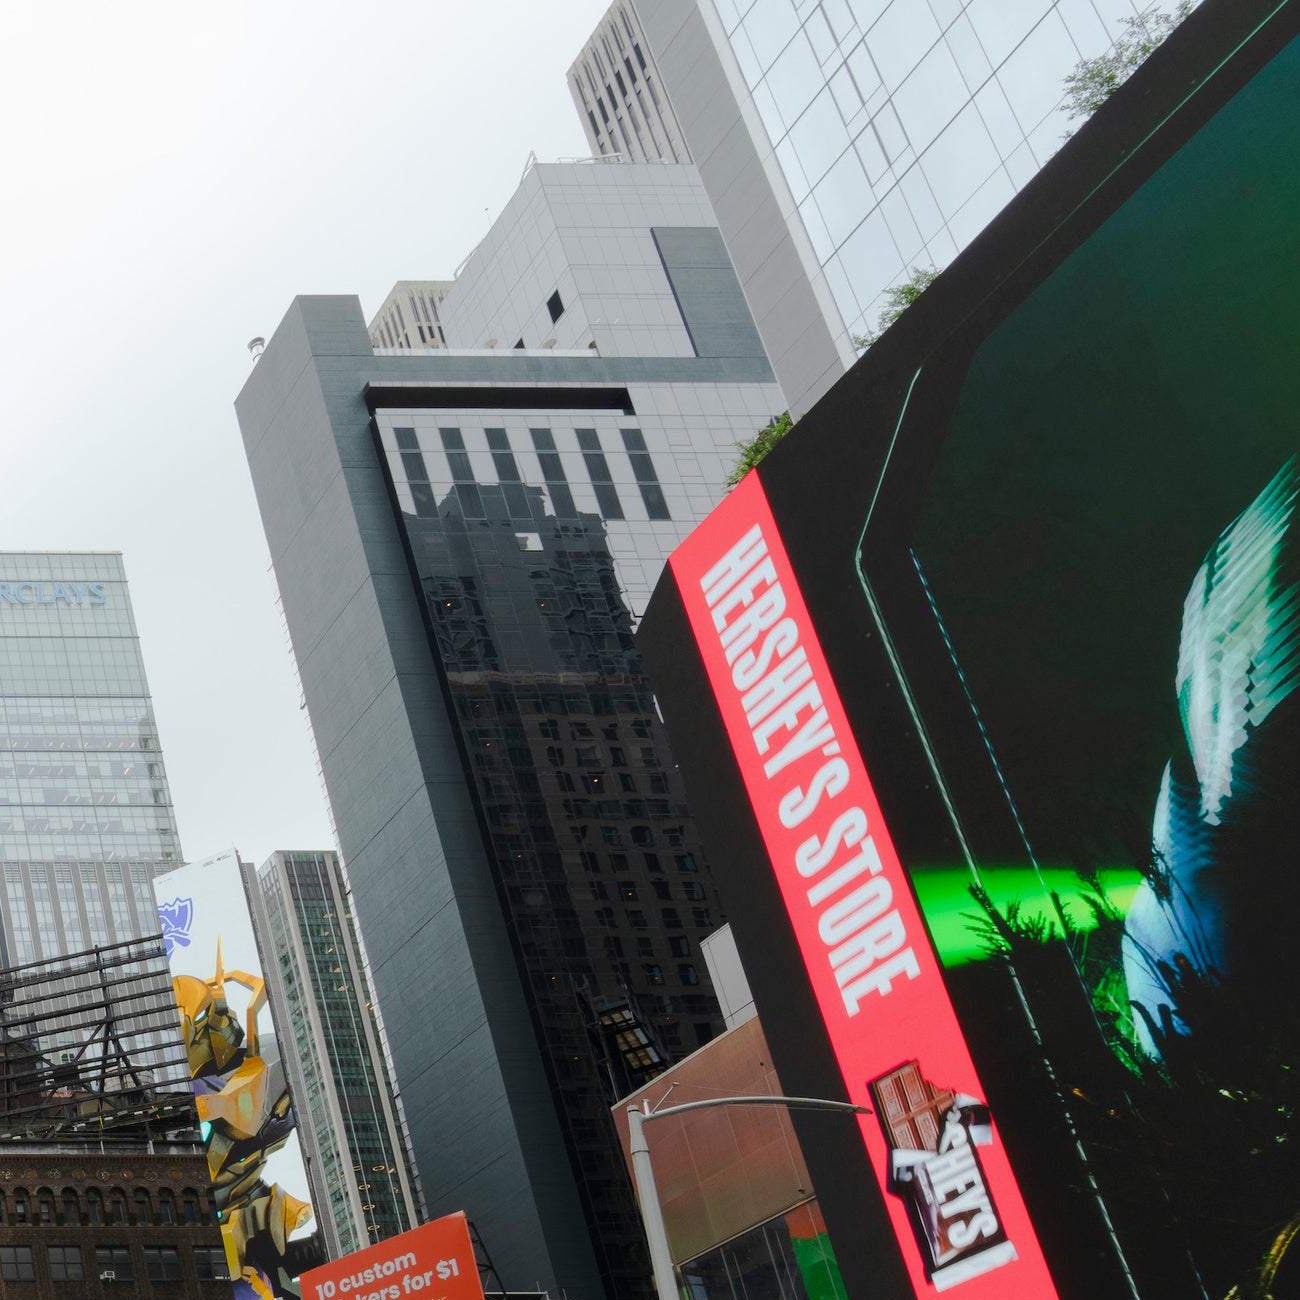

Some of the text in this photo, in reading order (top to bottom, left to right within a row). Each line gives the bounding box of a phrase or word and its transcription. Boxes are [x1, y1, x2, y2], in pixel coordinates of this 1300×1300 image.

[700, 522, 921, 1018] HERSHEY'S STORE
[315, 1251, 417, 1300] 10 custom
[402, 1269, 433, 1293] for
[436, 1258, 460, 1280] $1
